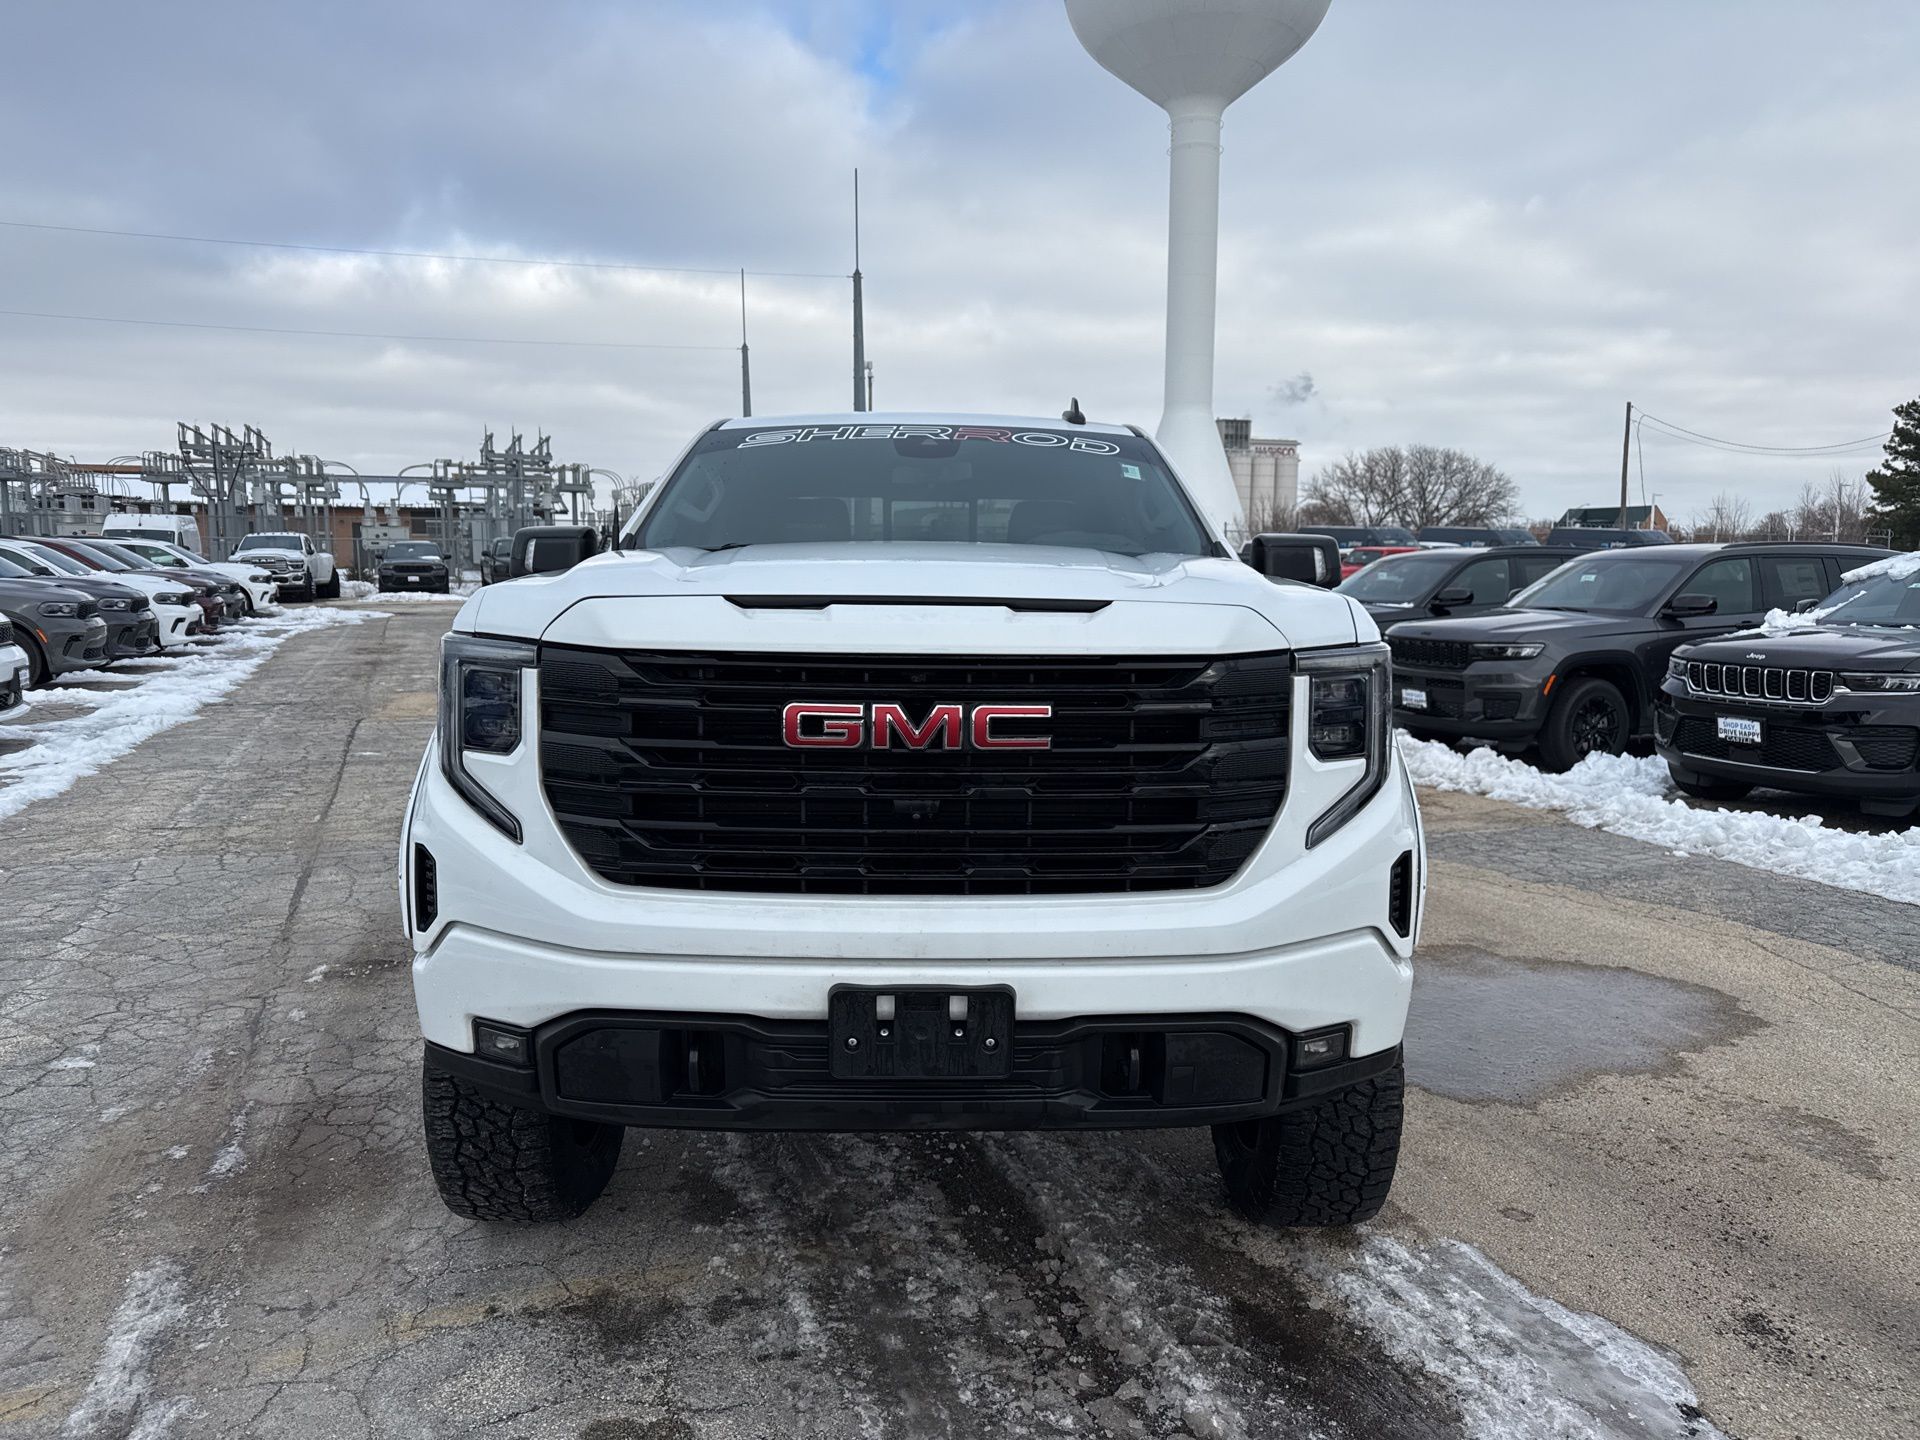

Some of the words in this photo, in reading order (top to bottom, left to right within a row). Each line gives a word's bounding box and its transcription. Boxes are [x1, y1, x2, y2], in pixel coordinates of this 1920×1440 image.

[737, 425, 1120, 456] SHERROD
[1746, 652, 1765, 660] Jeep
[783, 703, 1051, 749] GMC
[1722, 720, 1739, 729] SHOP
[1719, 727, 1737, 736] DRIVE
[1738, 729, 1760, 739] HAPPY
